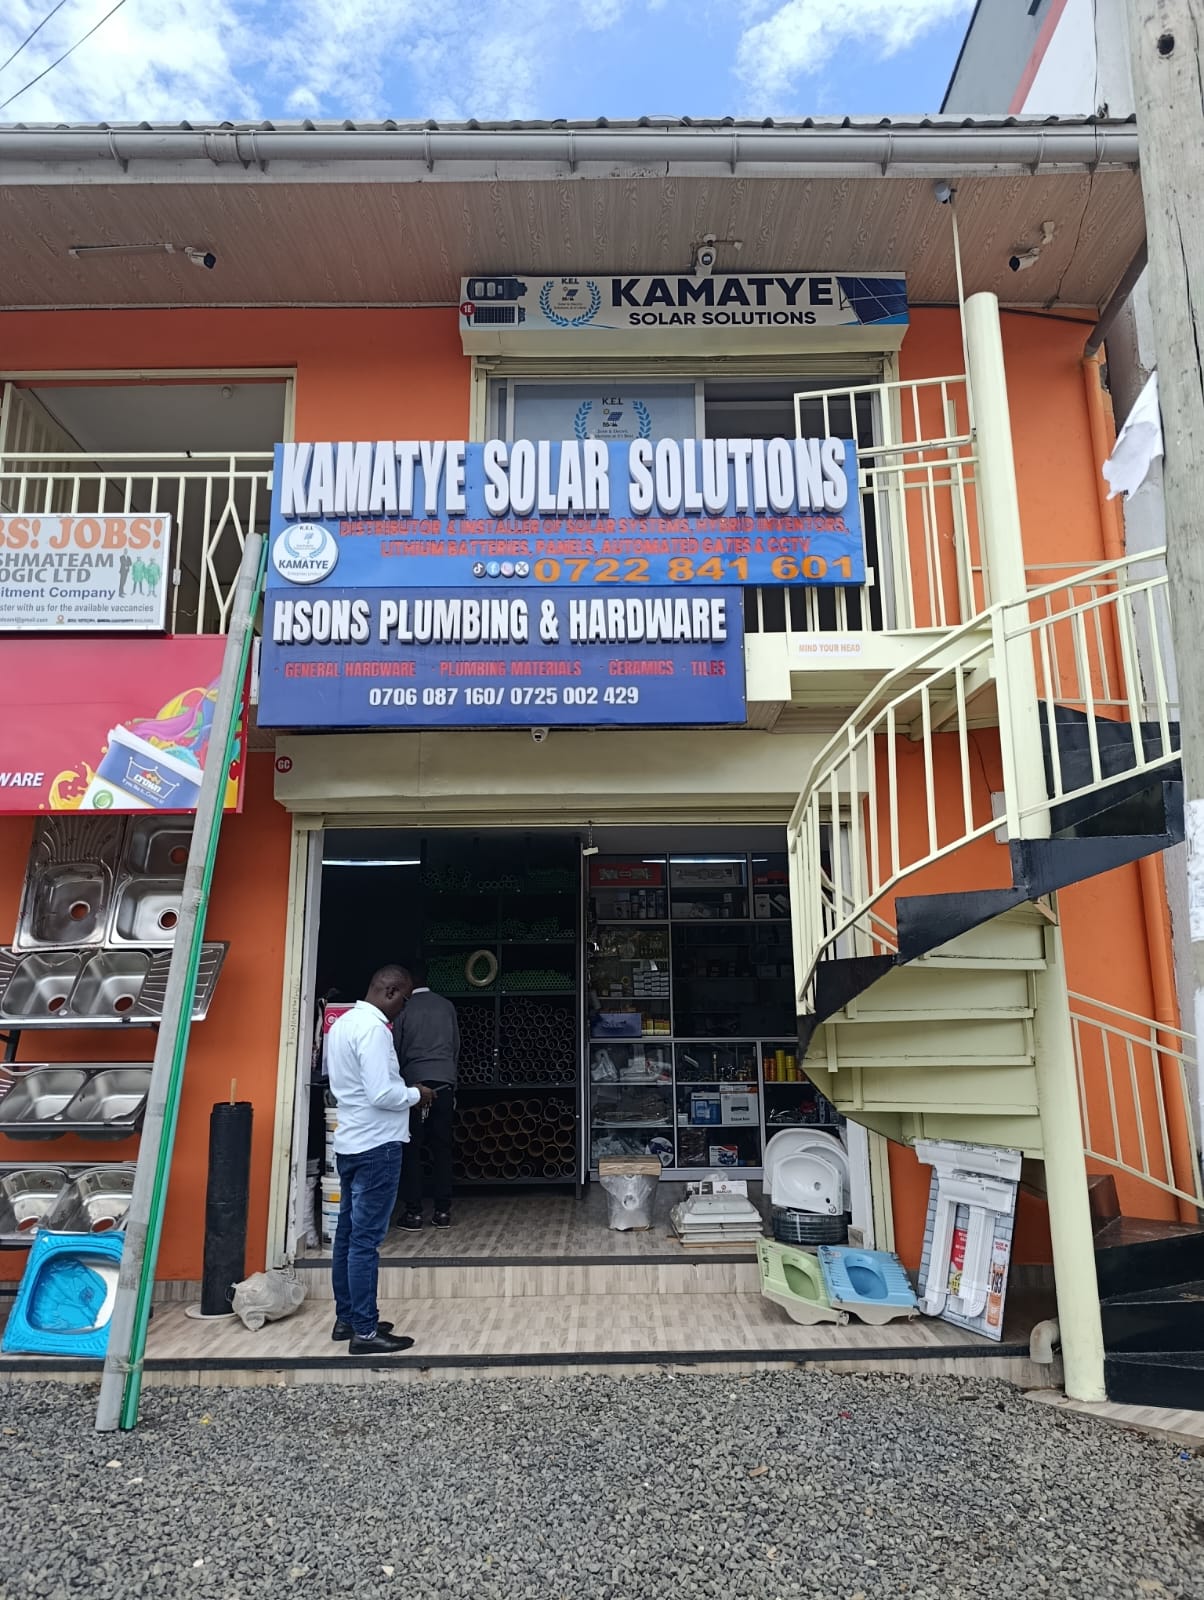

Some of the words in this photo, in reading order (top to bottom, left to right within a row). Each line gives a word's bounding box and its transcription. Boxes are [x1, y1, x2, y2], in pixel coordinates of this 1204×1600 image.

[612, 277, 833, 307] KAMATYE
[463, 304, 473, 313] 1E
[629, 312, 696, 325] SOLAR
[702, 311, 816, 325] SOLUTIONS
[280, 440, 466, 518] KAMATYE
[483, 438, 609, 516] SOLAR
[629, 437, 848, 515] SOLUTIONS
[0, 517, 41, 549] S!
[49, 517, 163, 549] JOBS!
[339, 519, 441, 536] DISTRIBUTOR
[446, 519, 457, 535] &
[460, 518, 539, 535] INSTALLER
[543, 518, 563, 534] OF
[566, 518, 616, 534] SOLAR
[618, 517, 693, 537] SYSTEMS,
[695, 516, 754, 533] HYBRID
[381, 539, 444, 556] LITHIUM
[447, 539, 533, 559] BATTERIES,
[535, 538, 598, 559] PANELS,
[602, 538, 699, 555] AUTOMATED
[702, 537, 751, 554] GATES
[754, 537, 765, 554] &
[767, 536, 811, 553] CCTV
[0, 553, 114, 568] HMATEAM
[278, 559, 329, 569] KAMATYE
[533, 556, 650, 583] 0722
[668, 555, 749, 582] 841
[771, 554, 852, 580] 601
[53, 568, 91, 583] LTD
[1, 586, 44, 598] itment
[49, 586, 116, 600] Company
[17, 603, 33, 611] with
[47, 603, 58, 611] for
[60, 603, 73, 611] the
[74, 603, 109, 611] available
[111, 603, 154, 611] vaccancies
[273, 600, 371, 643] HSONS
[379, 599, 528, 643] PLUMBING
[539, 599, 560, 643] &
[569, 598, 727, 642] HARDWARE
[799, 644, 817, 652] MIND
[820, 643, 839, 652] YOUR
[841, 643, 860, 652] HEAD
[285, 661, 340, 678] GENERAL
[345, 660, 416, 677] HARDWARE
[439, 660, 505, 677] PLUMBING
[511, 660, 582, 676] MATERIALS
[609, 660, 674, 676] CERAMICS
[691, 660, 726, 676] TILES
[369, 688, 417, 705] 0706
[422, 687, 458, 705] 087
[464, 687, 505, 705] 160/
[510, 687, 557, 705] 0725
[563, 687, 598, 704] 002
[603, 687, 639, 704] 429
[0, 772, 44, 787] WARE
